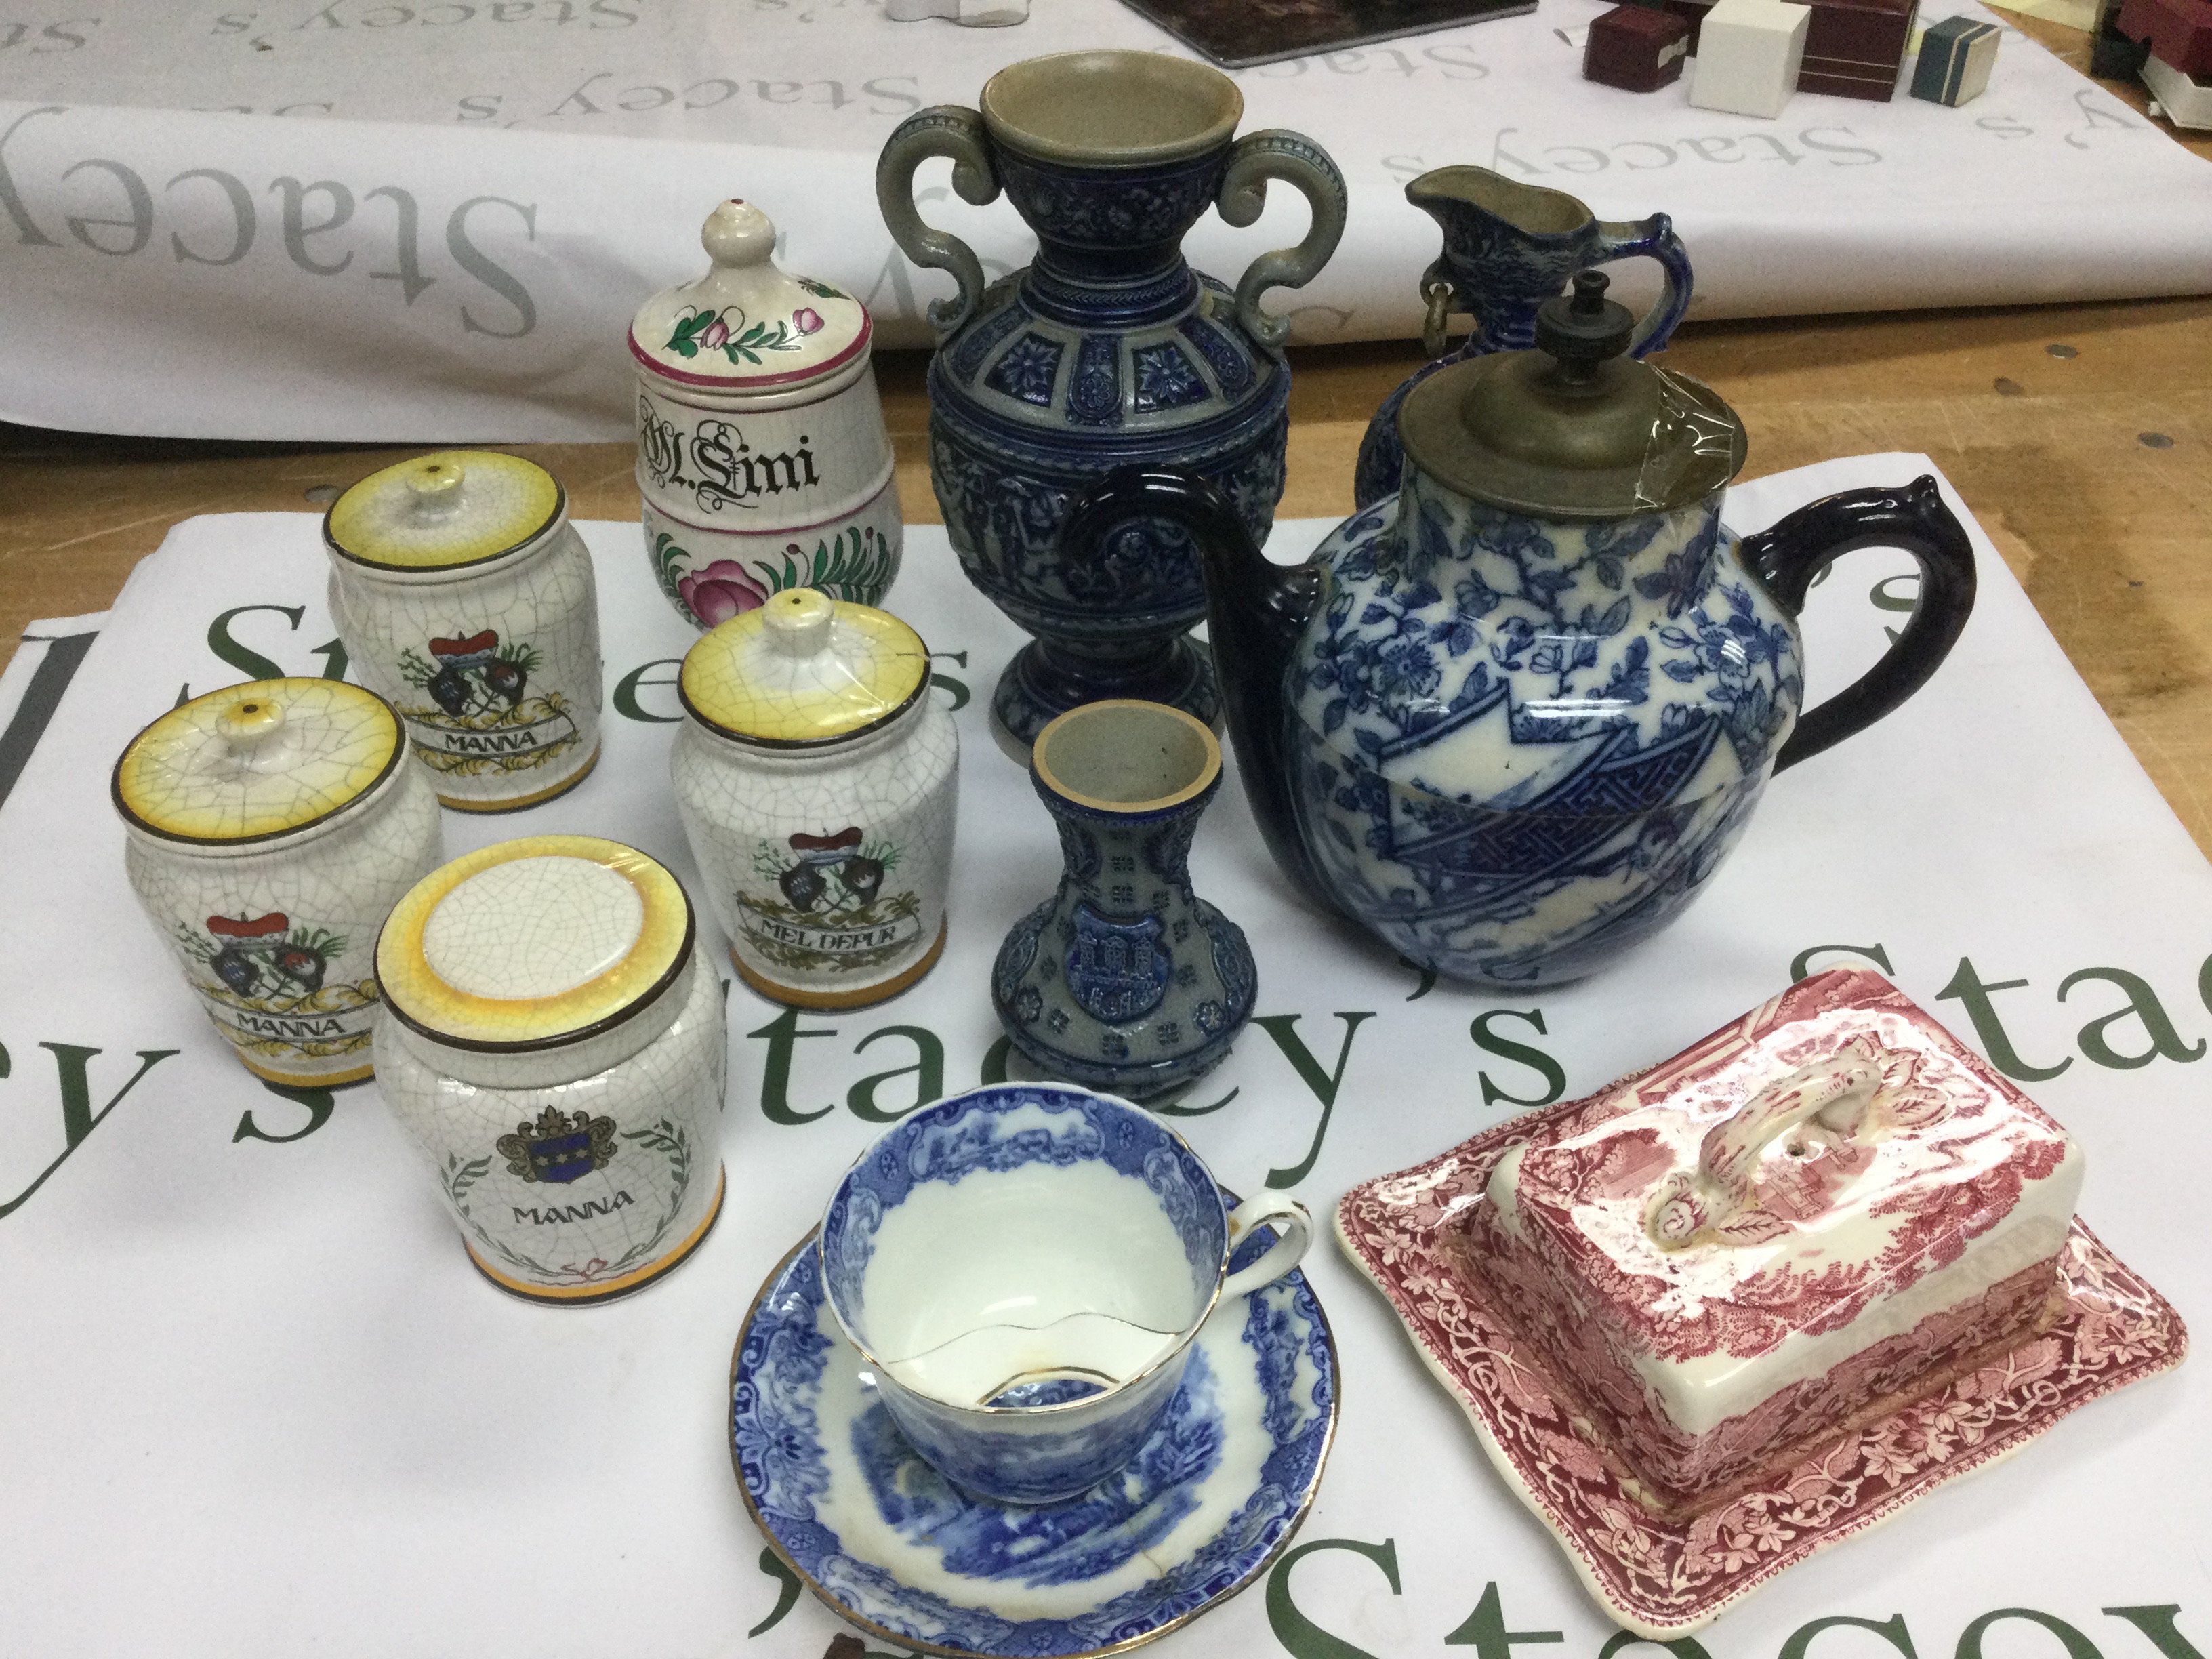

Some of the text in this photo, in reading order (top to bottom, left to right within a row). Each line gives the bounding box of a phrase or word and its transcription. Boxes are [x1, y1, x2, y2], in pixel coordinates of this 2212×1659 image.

[445, 731, 538, 753] MANNA
[761, 919, 813, 947] MEL
[236, 1012, 348, 1038] MANNA
[511, 1189, 636, 1225] MANNA
